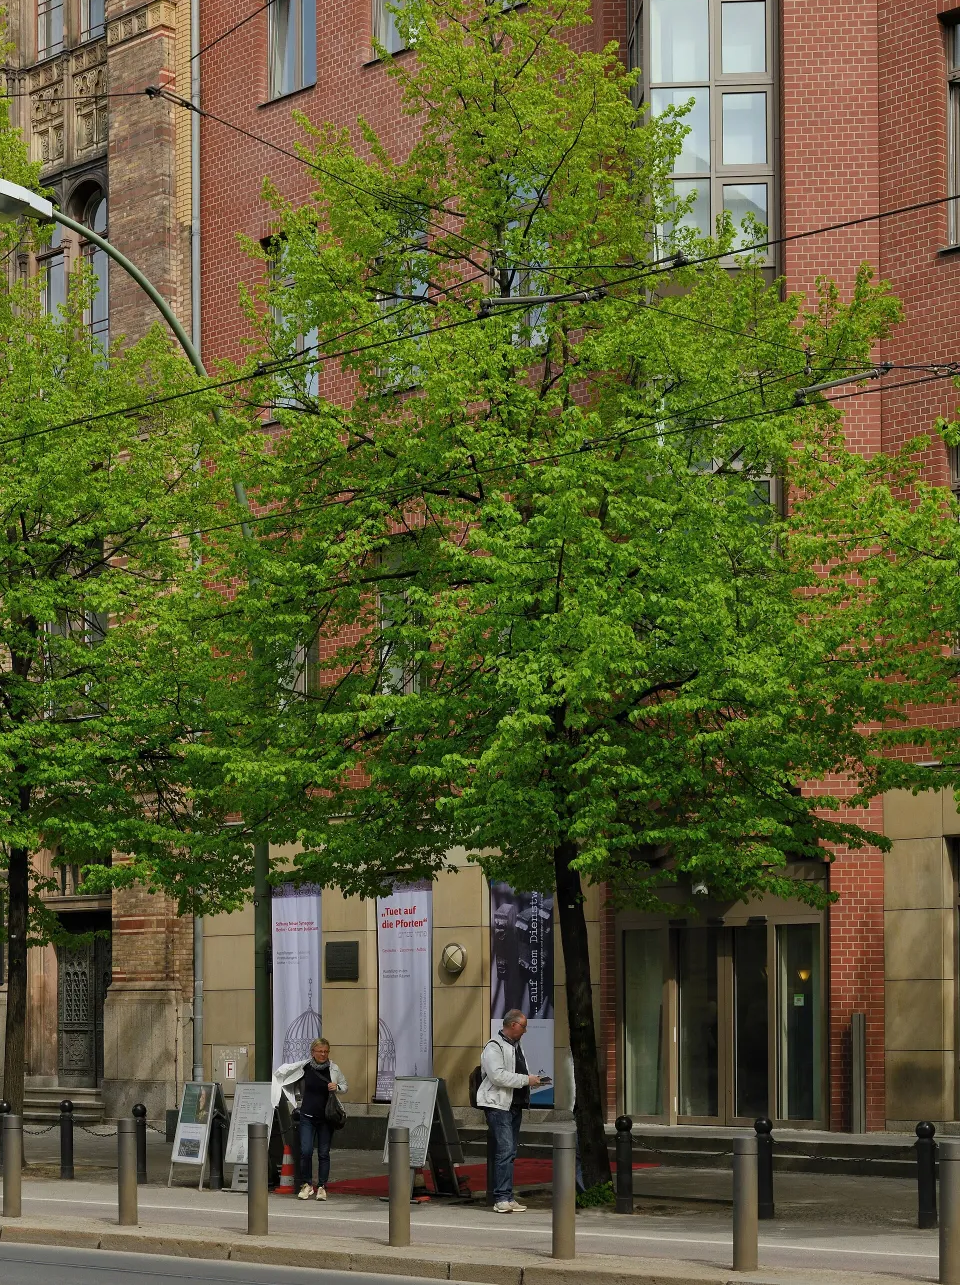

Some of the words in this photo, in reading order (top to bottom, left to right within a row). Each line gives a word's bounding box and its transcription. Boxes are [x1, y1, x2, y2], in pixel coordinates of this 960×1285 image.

[381, 907, 402, 917] „Tuet
[403, 905, 417, 915] auf
[381, 919, 394, 929] die
[395, 917, 428, 929] Pforten“
[529, 949, 538, 973] dem
[529, 978, 538, 1003] auf
[227, 1062, 233, 1078] F
